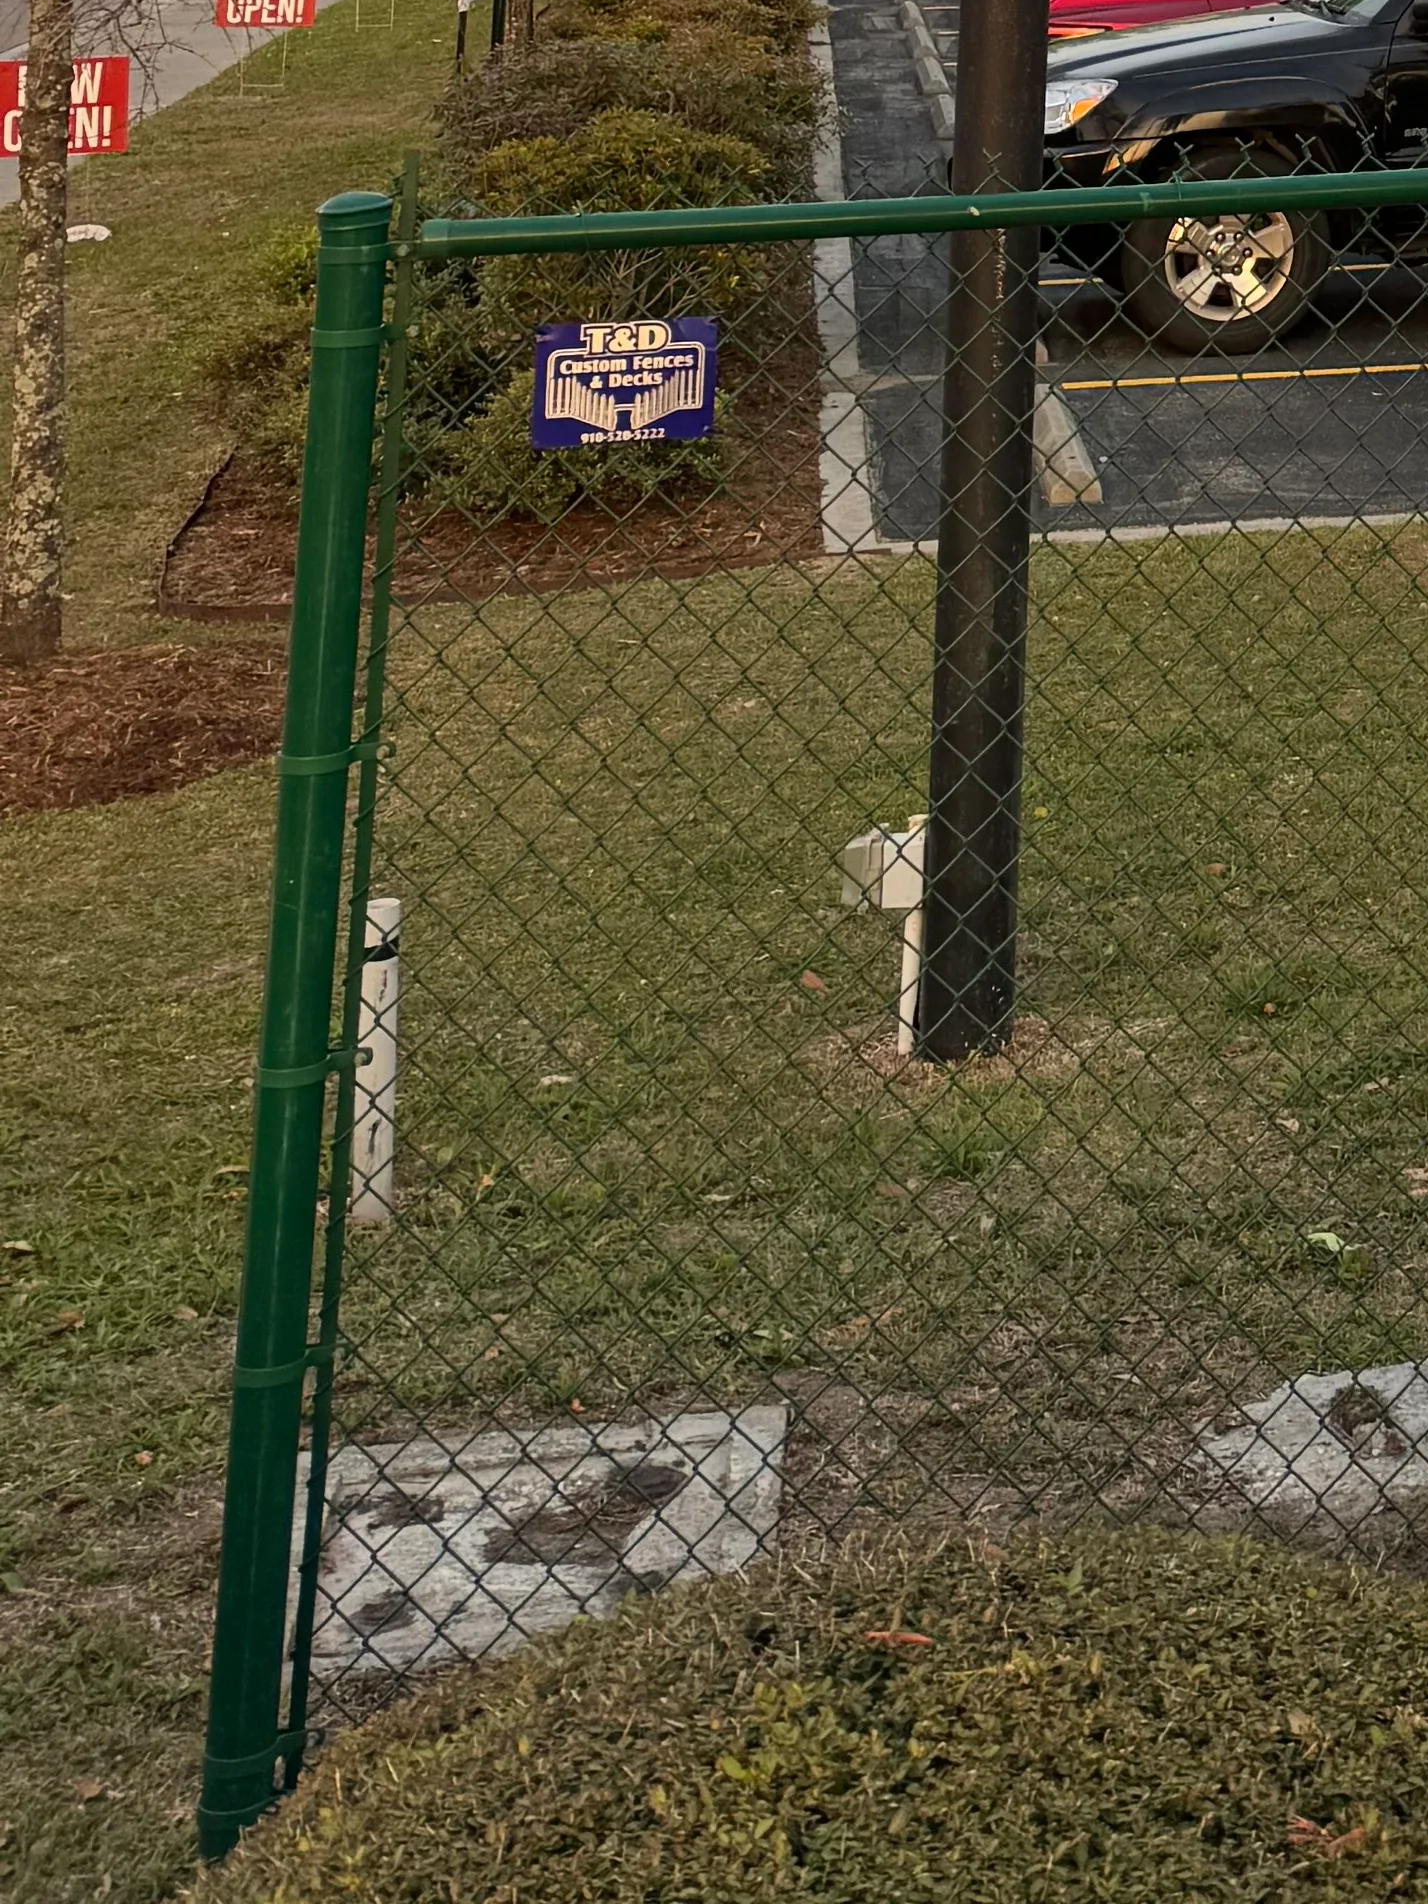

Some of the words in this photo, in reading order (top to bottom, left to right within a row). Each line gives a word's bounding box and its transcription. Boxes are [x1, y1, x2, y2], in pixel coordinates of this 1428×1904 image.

[3, 105, 113, 152] ON!
[582, 322, 669, 356] T&D
[559, 358, 628, 375] Custom
[632, 354, 694, 370] Fences
[589, 375, 604, 389] &
[608, 371, 664, 388] Decks
